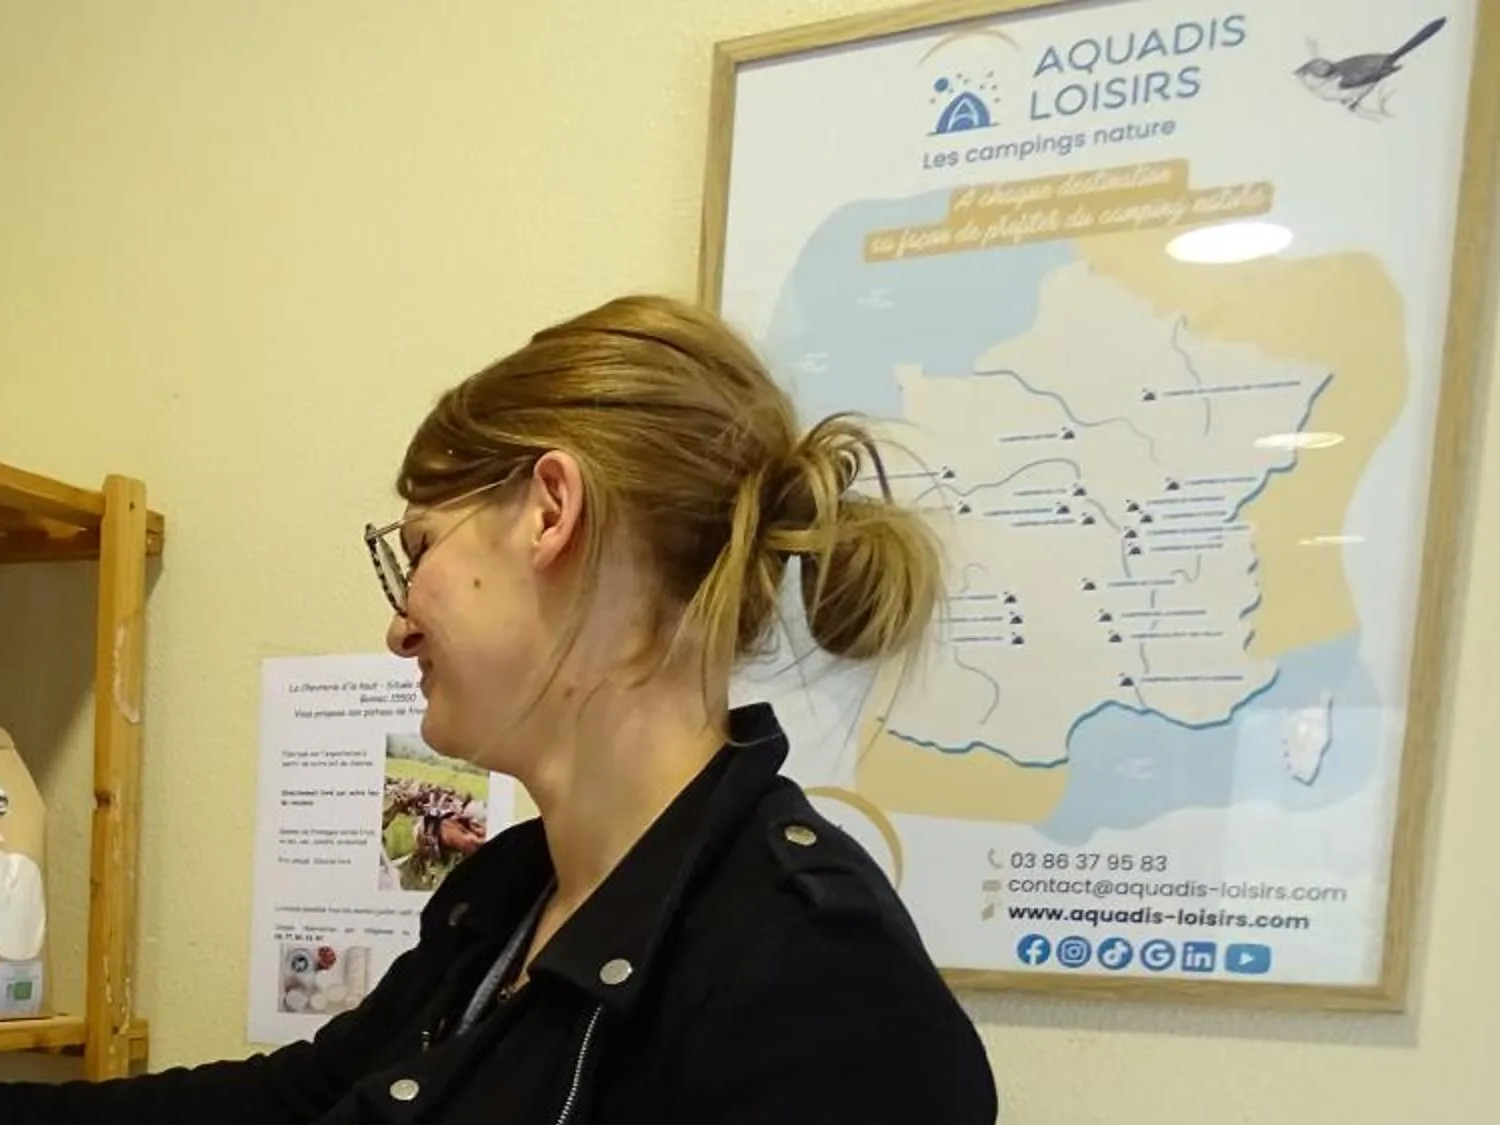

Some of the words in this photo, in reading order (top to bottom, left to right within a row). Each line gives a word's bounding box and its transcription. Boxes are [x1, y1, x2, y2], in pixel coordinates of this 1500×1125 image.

[1033, 14, 1246, 77] AQUADIS
[1029, 67, 1201, 121] LOISIRS
[922, 149, 958, 169] Les
[965, 132, 1086, 161] campings
[1093, 119, 1176, 144] nature
[1011, 852, 1037, 869] 03
[1042, 852, 1069, 870] 86
[1075, 854, 1100, 871] 37
[1107, 854, 1134, 872] 95
[1139, 854, 1168, 872] 83
[1008, 876, 1348, 903] contact@aquadis-loisirs.com
[1008, 904, 1311, 930] www.aquadis-loisirs.com
